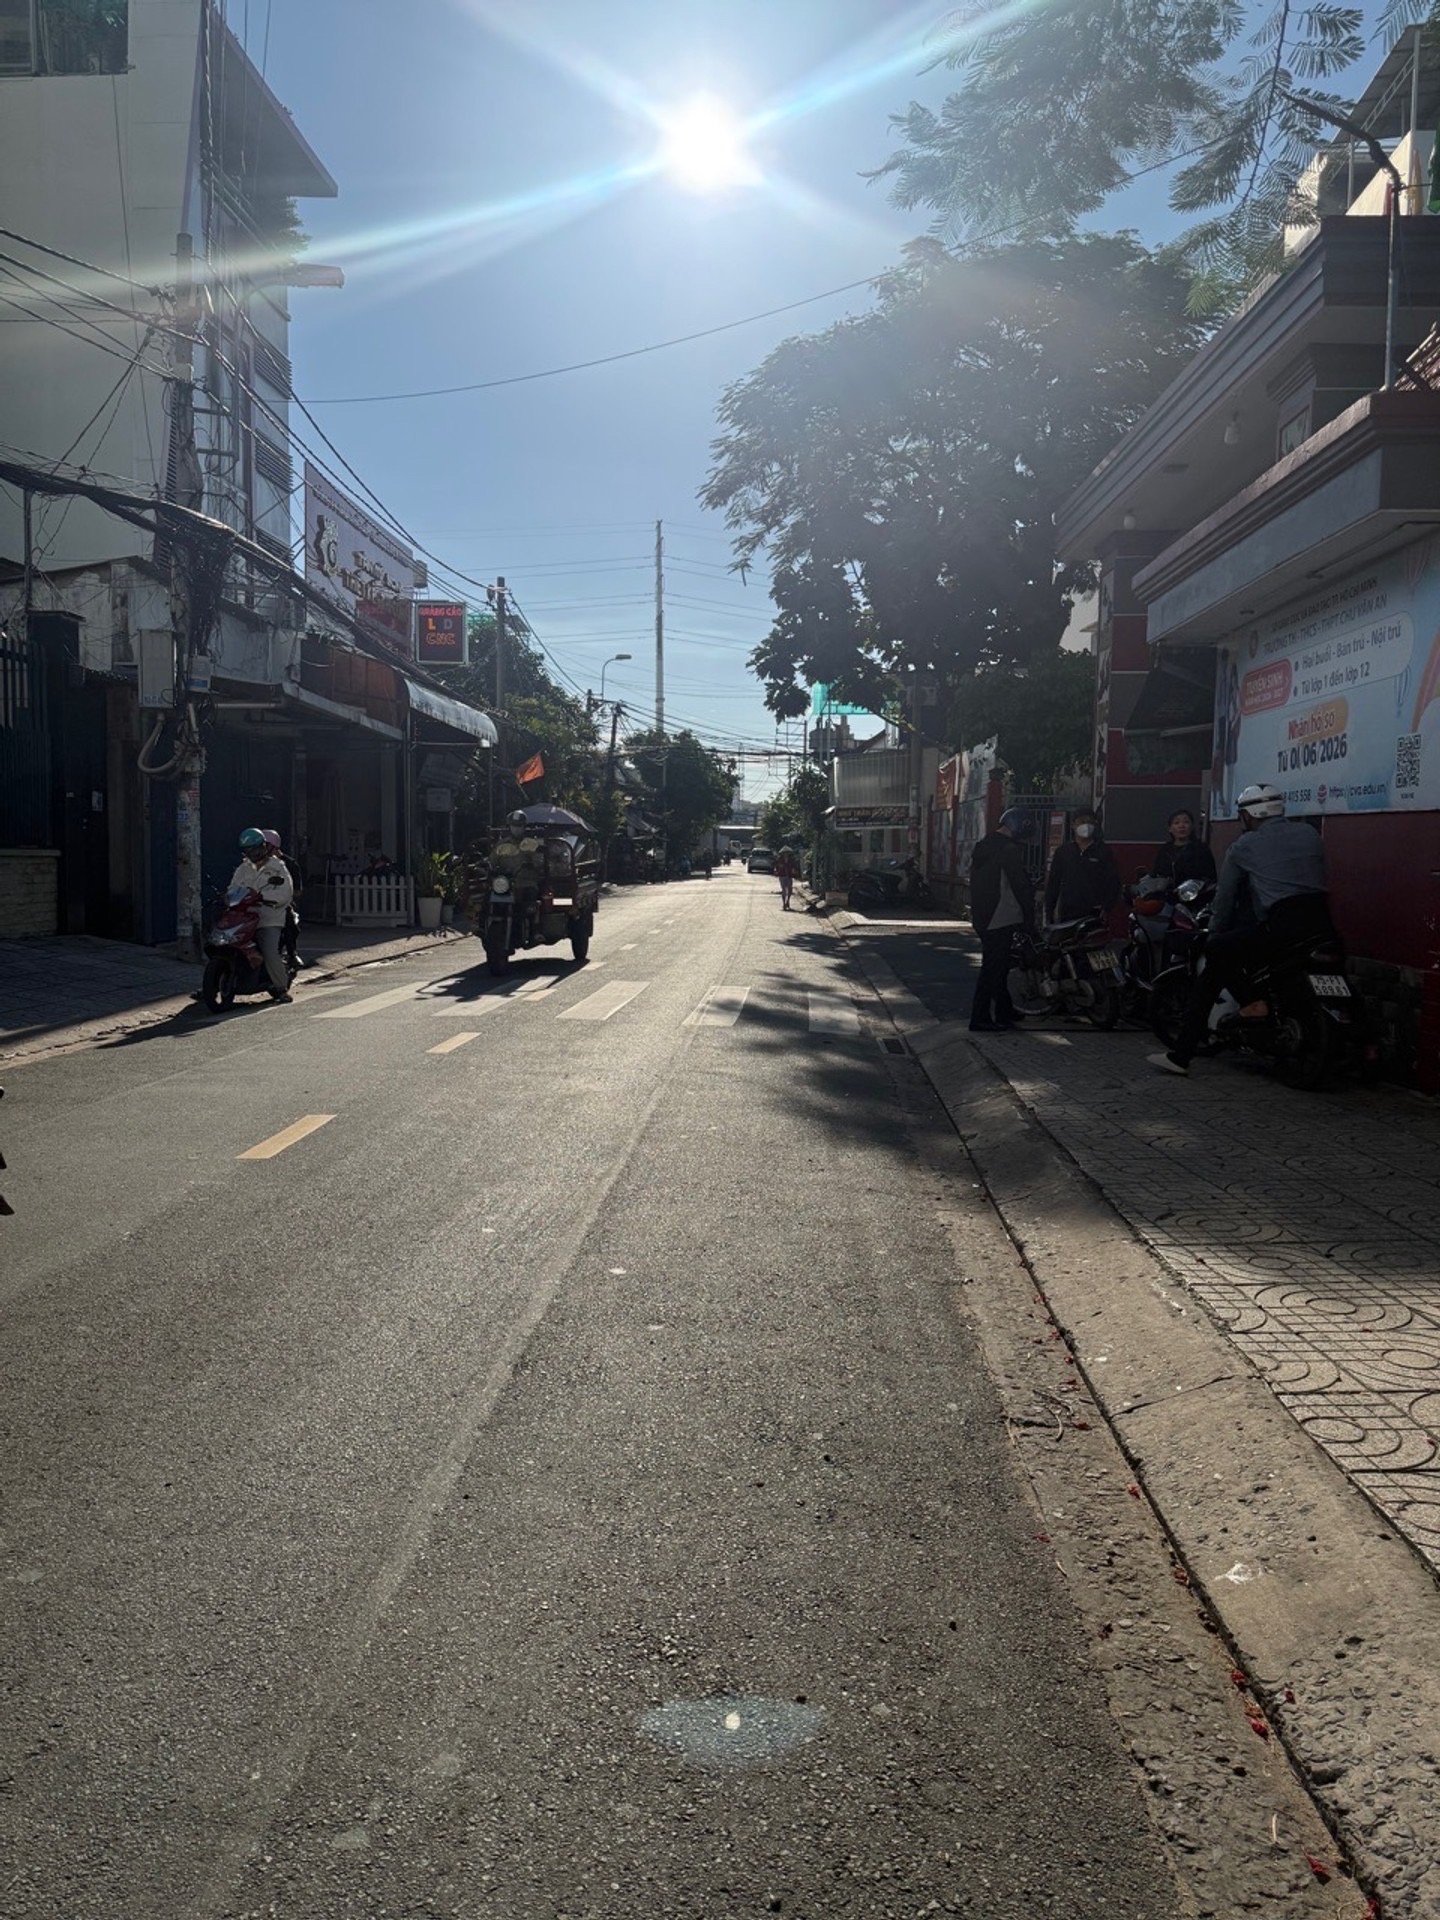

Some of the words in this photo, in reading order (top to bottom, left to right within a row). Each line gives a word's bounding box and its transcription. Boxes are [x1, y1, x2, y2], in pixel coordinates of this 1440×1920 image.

[446, 605, 462, 616] CÁO
[1300, 622, 1317, 641] THCS
[1374, 592, 1387, 611] AN
[1337, 640, 1352, 658] Bán
[1353, 633, 1365, 653] trú
[1371, 626, 1386, 648] Nội
[1387, 620, 1401, 640] trú
[1267, 671, 1284, 690] SINH
[1311, 676, 1323, 694] lớp
[1329, 670, 1344, 687] đến
[1345, 665, 1358, 685] lớp
[1360, 661, 1370, 678] 12
[1311, 710, 1322, 732] hồ
[1324, 708, 1336, 729] sơ
[1277, 748, 1288, 773] Từ
